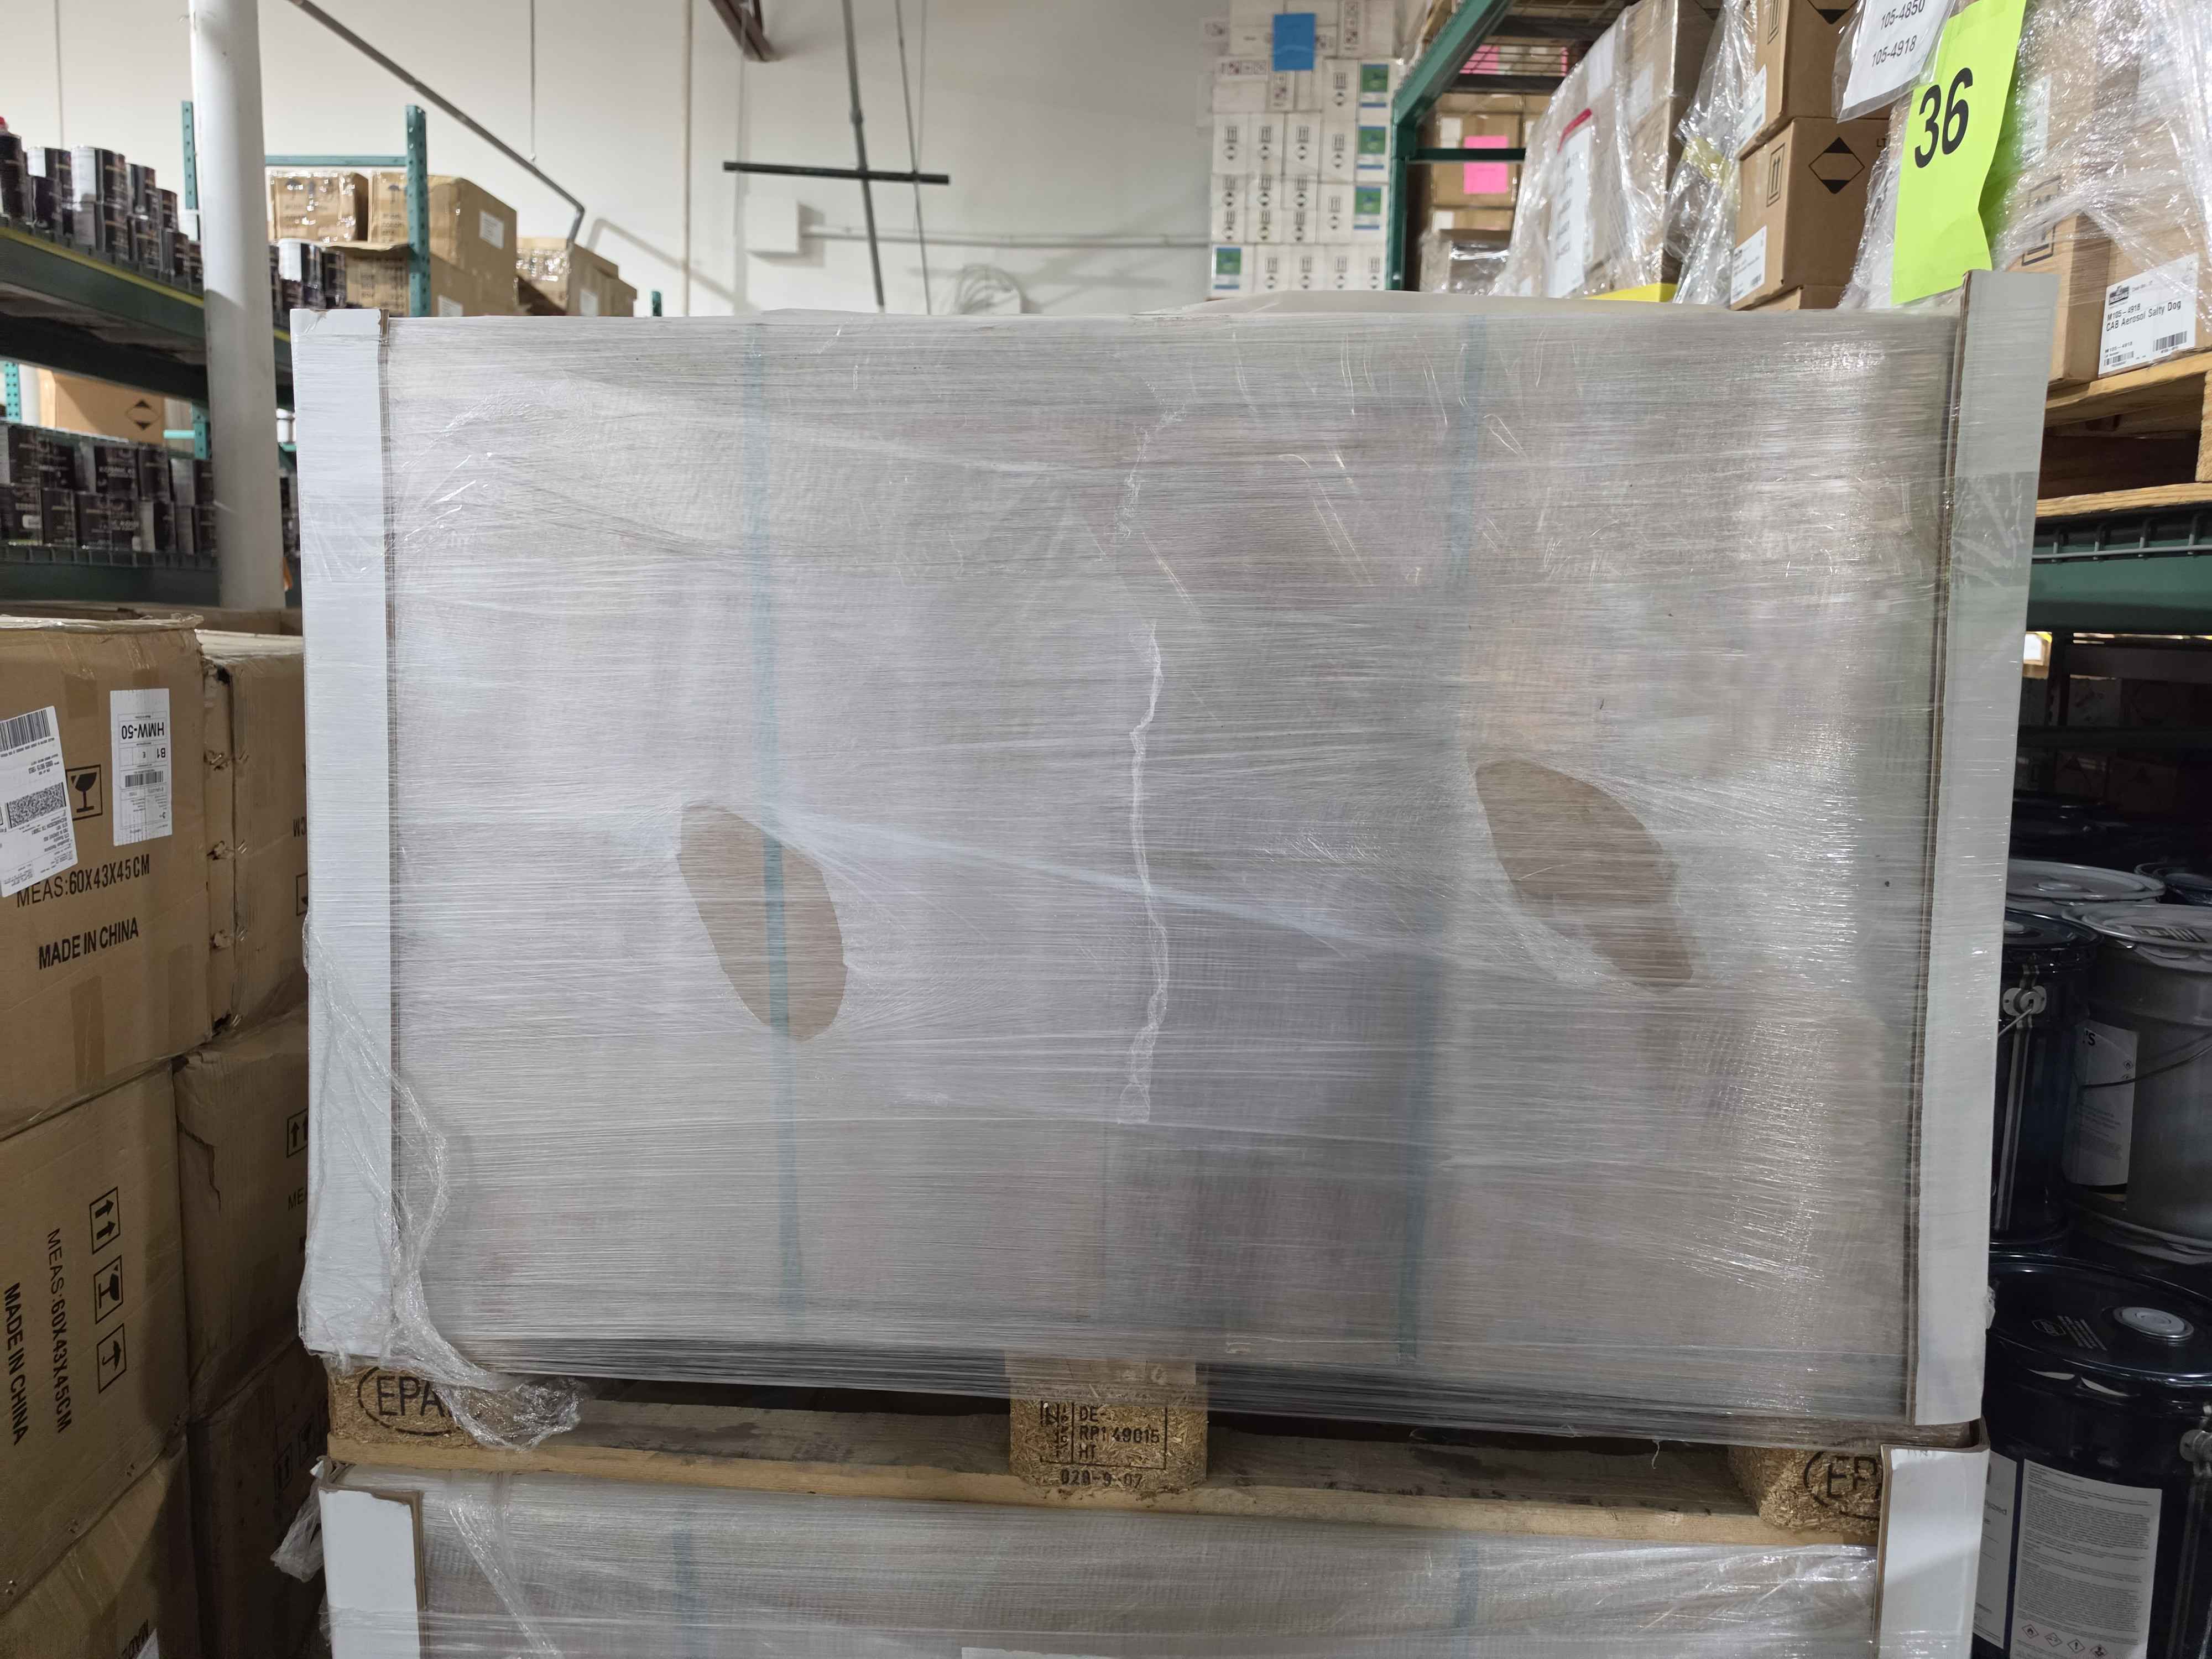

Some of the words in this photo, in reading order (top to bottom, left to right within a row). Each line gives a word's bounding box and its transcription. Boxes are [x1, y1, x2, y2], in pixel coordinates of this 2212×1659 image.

[1880, 0, 1926, 30] 105-4850
[1872, 35, 1917, 67] 105-4918
[1914, 67, 1973, 169] 36
[2106, 320, 2119, 332] CAB
[2121, 310, 2146, 327] Aerosol
[2148, 306, 2164, 317] Salty
[2168, 301, 2181, 311] Dog
[121, 721, 165, 740] HMW-50
[156, 747, 166, 758] B1
[39, 935, 81, 970] MADE
[84, 930, 96, 954] IN
[100, 916, 139, 949] CHINA
[4, 1282, 24, 1352] MADE
[47, 1228, 72, 1434] MEAS:60X43X45CM
[8, 1347, 25, 1376] IN
[11, 1374, 29, 1447] CHINA
[376, 1376, 453, 1417] EPA
[1827, 1454, 1881, 1499] EP
